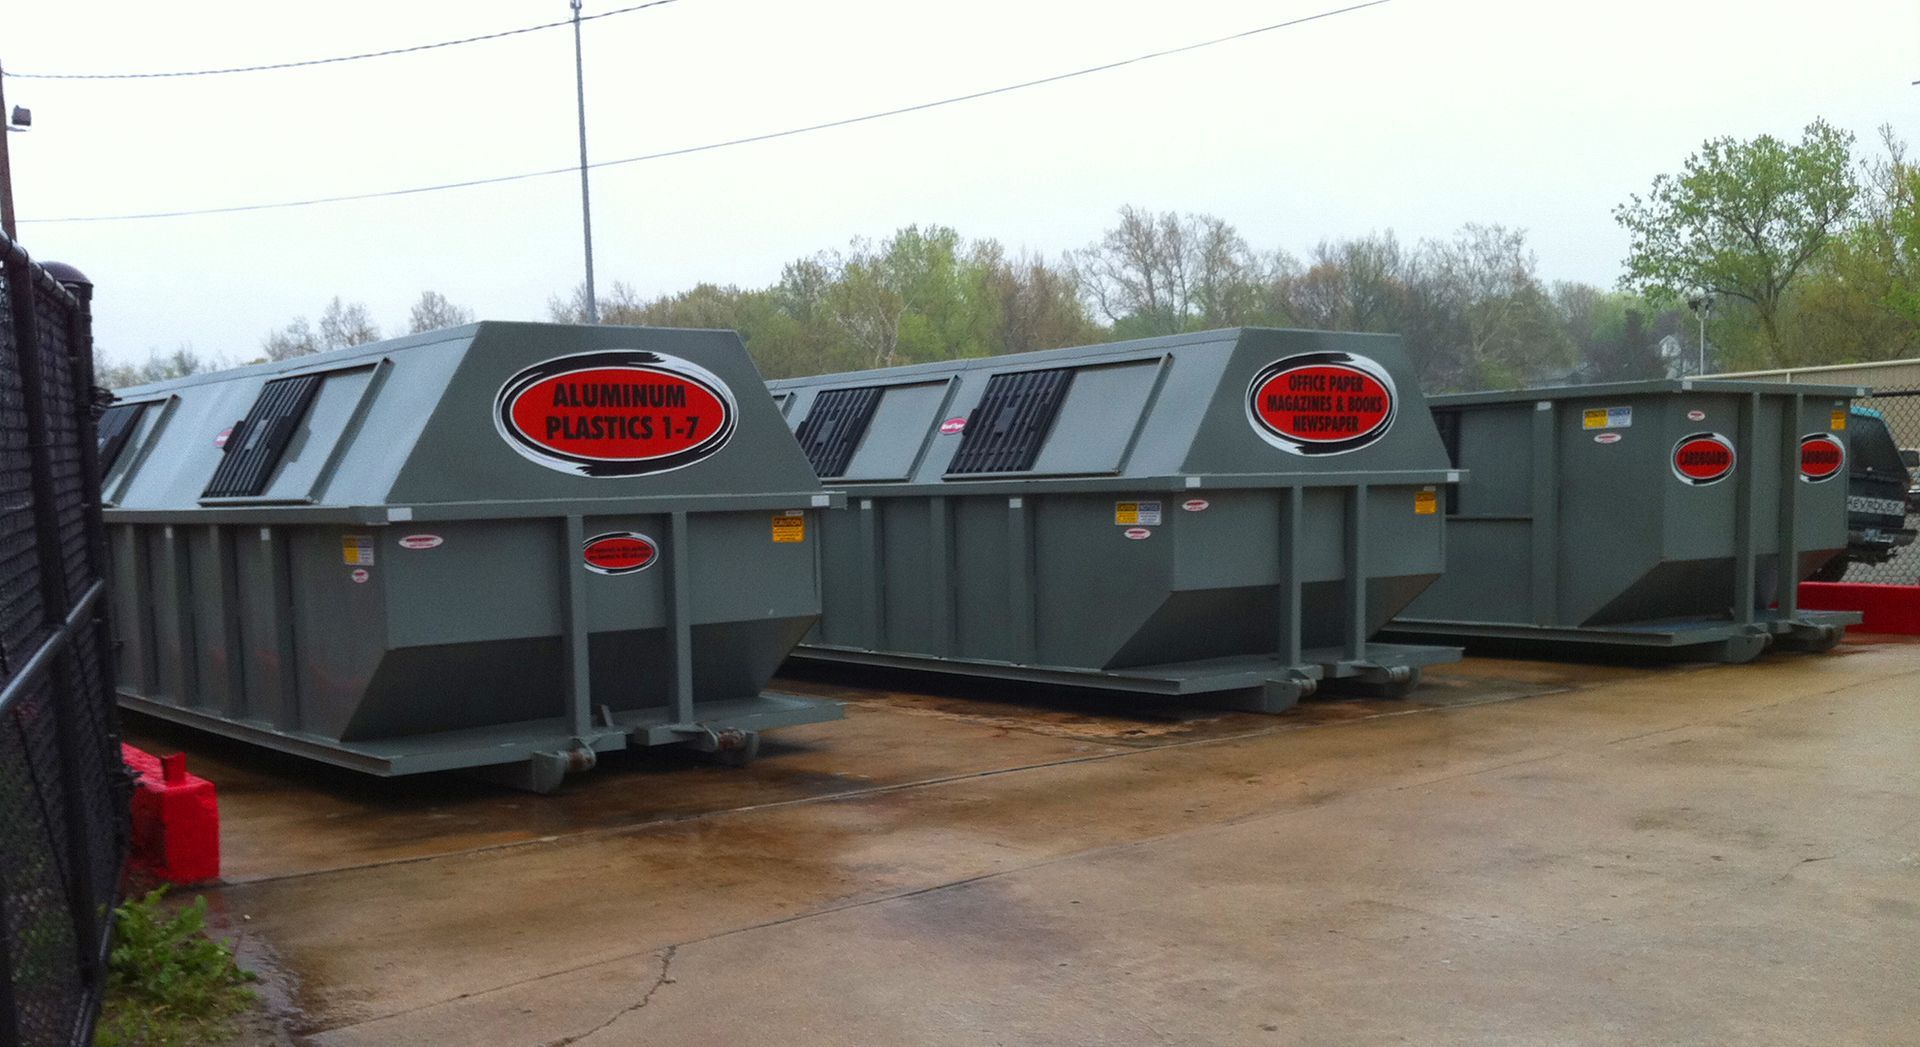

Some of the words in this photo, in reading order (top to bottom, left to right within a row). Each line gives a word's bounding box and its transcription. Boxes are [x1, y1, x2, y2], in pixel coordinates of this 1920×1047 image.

[1289, 375, 1325, 391] OFFICE
[1329, 375, 1364, 392] PAPER
[553, 383, 686, 408] ALUMINUM
[1267, 395, 1331, 412] MAGAZINES
[1337, 395, 1344, 411] &
[1348, 396, 1382, 412] BOOKS
[546, 416, 653, 440] PLASTICS
[663, 416, 699, 440] 1-7
[1293, 415, 1359, 432] NEWSPAPER
[1801, 450, 1840, 464] ARDBOARD
